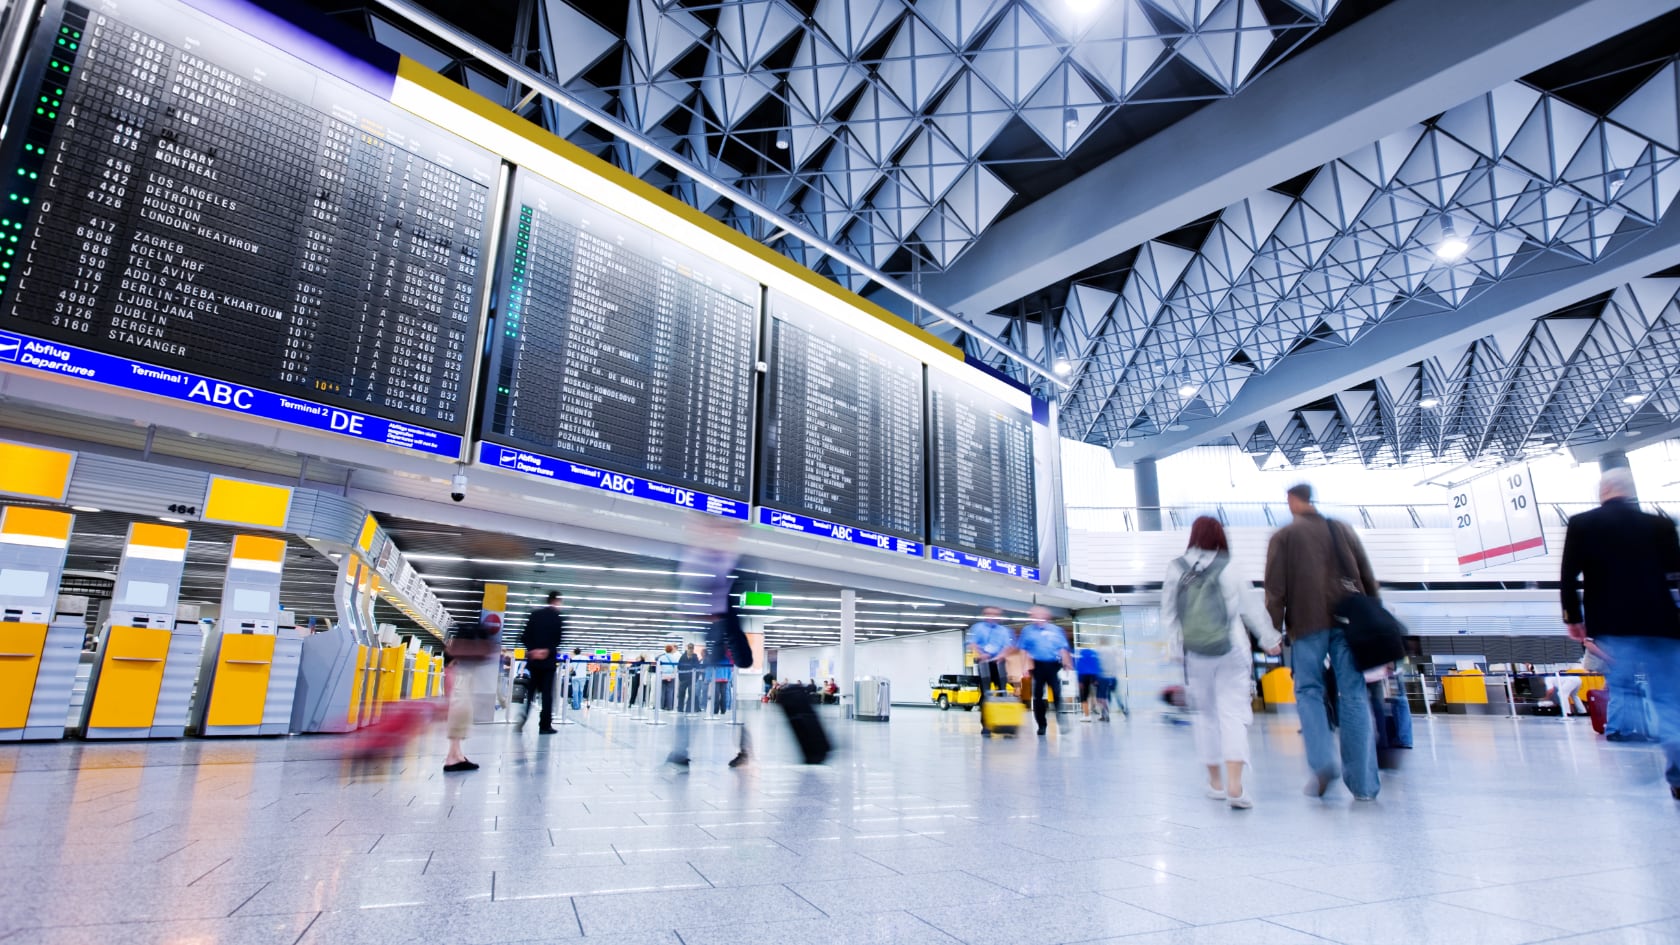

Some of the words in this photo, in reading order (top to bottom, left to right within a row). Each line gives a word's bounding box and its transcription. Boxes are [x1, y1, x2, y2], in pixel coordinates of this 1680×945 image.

[94, 26, 102, 37] L
[128, 42, 162, 63] 3102
[178, 63, 238, 96] HELSINKI
[181, 53, 241, 86] VARADERO
[80, 71, 88, 82] L
[87, 48, 95, 59] L
[131, 67, 156, 84] 462
[172, 85, 210, 107] MIAMI
[91, 38, 98, 48] L
[175, 74, 236, 106] PORTLAND
[71, 105, 78, 116] L
[116, 124, 141, 139] 494
[158, 139, 214, 166] CALGARY
[65, 118, 75, 128] A
[112, 134, 138, 150] 875
[155, 150, 218, 180] MONTREAL
[56, 153, 63, 163] L
[103, 170, 129, 185] 442
[146, 184, 203, 210] DETROIT
[60, 141, 67, 151] L
[106, 158, 131, 173] 456
[149, 173, 174, 188] LOS
[181, 185, 237, 210] ANGELES
[53, 165, 60, 175] L
[100, 182, 126, 197] 440
[143, 196, 201, 222] HOUSTON
[49, 177, 56, 188] L
[87, 191, 122, 208] 4726
[140, 207, 259, 253] LONDON-HEATHROW
[41, 202, 51, 212] O
[89, 218, 116, 232] 417
[133, 231, 184, 254] ZAGREB
[38, 215, 45, 225] L
[76, 226, 112, 244] 6808
[130, 243, 173, 263] KOELN
[181, 259, 205, 272] HBF
[34, 227, 41, 237] L
[82, 242, 109, 256] 686
[128, 255, 152, 270] TEL
[161, 266, 195, 282] AVIV
[26, 253, 33, 263] L
[77, 267, 102, 281] 176
[121, 279, 219, 315] BERLIN-TEGEL
[30, 240, 38, 250] L
[79, 254, 105, 269] 590
[123, 267, 167, 287] ADDIS
[175, 282, 283, 320] ABEBA-KHARTOUM
[19, 279, 26, 289] L
[59, 290, 95, 306] 4980
[114, 304, 167, 326] DUBLIN
[23, 266, 32, 276] J
[74, 280, 99, 294] 117
[118, 292, 194, 320] LJUBLJANA
[15, 292, 22, 302] L
[55, 303, 92, 319] 3126
[111, 316, 164, 337] BERGEN
[11, 305, 18, 316] L
[51, 316, 88, 332] 3160
[108, 329, 186, 357] STAVANGER
[588, 320, 605, 332] YORK
[567, 340, 598, 357] CHICAGO
[568, 332, 595, 347] DALLAS
[24, 341, 71, 360] Abflug
[566, 349, 597, 365] DETROIT
[20, 353, 96, 377] Departures
[565, 358, 588, 371] PARIS
[131, 364, 181, 383] Terminal
[183, 376, 189, 385] 1
[188, 379, 254, 409] ABC
[562, 385, 602, 403] NUERNBERG
[561, 403, 592, 418] TORONTO
[562, 393, 593, 409] VILNIUS
[280, 398, 320, 415] Terminal
[321, 408, 328, 417] 2
[330, 411, 365, 435] DE
[560, 412, 595, 428] HELSINKI
[559, 422, 600, 438] AMSTERDAM
[557, 440, 585, 454] DUBLIN
[558, 431, 611, 451] POZNAN/POSEN
[517, 462, 554, 476] Departures
[518, 453, 541, 465] Abflug
[570, 465, 596, 477] Terminal
[600, 473, 634, 493] ABC
[1507, 474, 1522, 490] 10
[648, 482, 670, 494] Terminal
[670, 487, 675, 495] 2
[675, 489, 695, 507] DE
[1453, 493, 1468, 509] 20
[1511, 495, 1527, 511] 10
[168, 504, 195, 515] 464
[1457, 513, 1471, 529] 20
[831, 525, 853, 541] ABC
[877, 535, 890, 549] DE
[977, 558, 992, 570] ABC
[1008, 565, 1017, 575] DE
